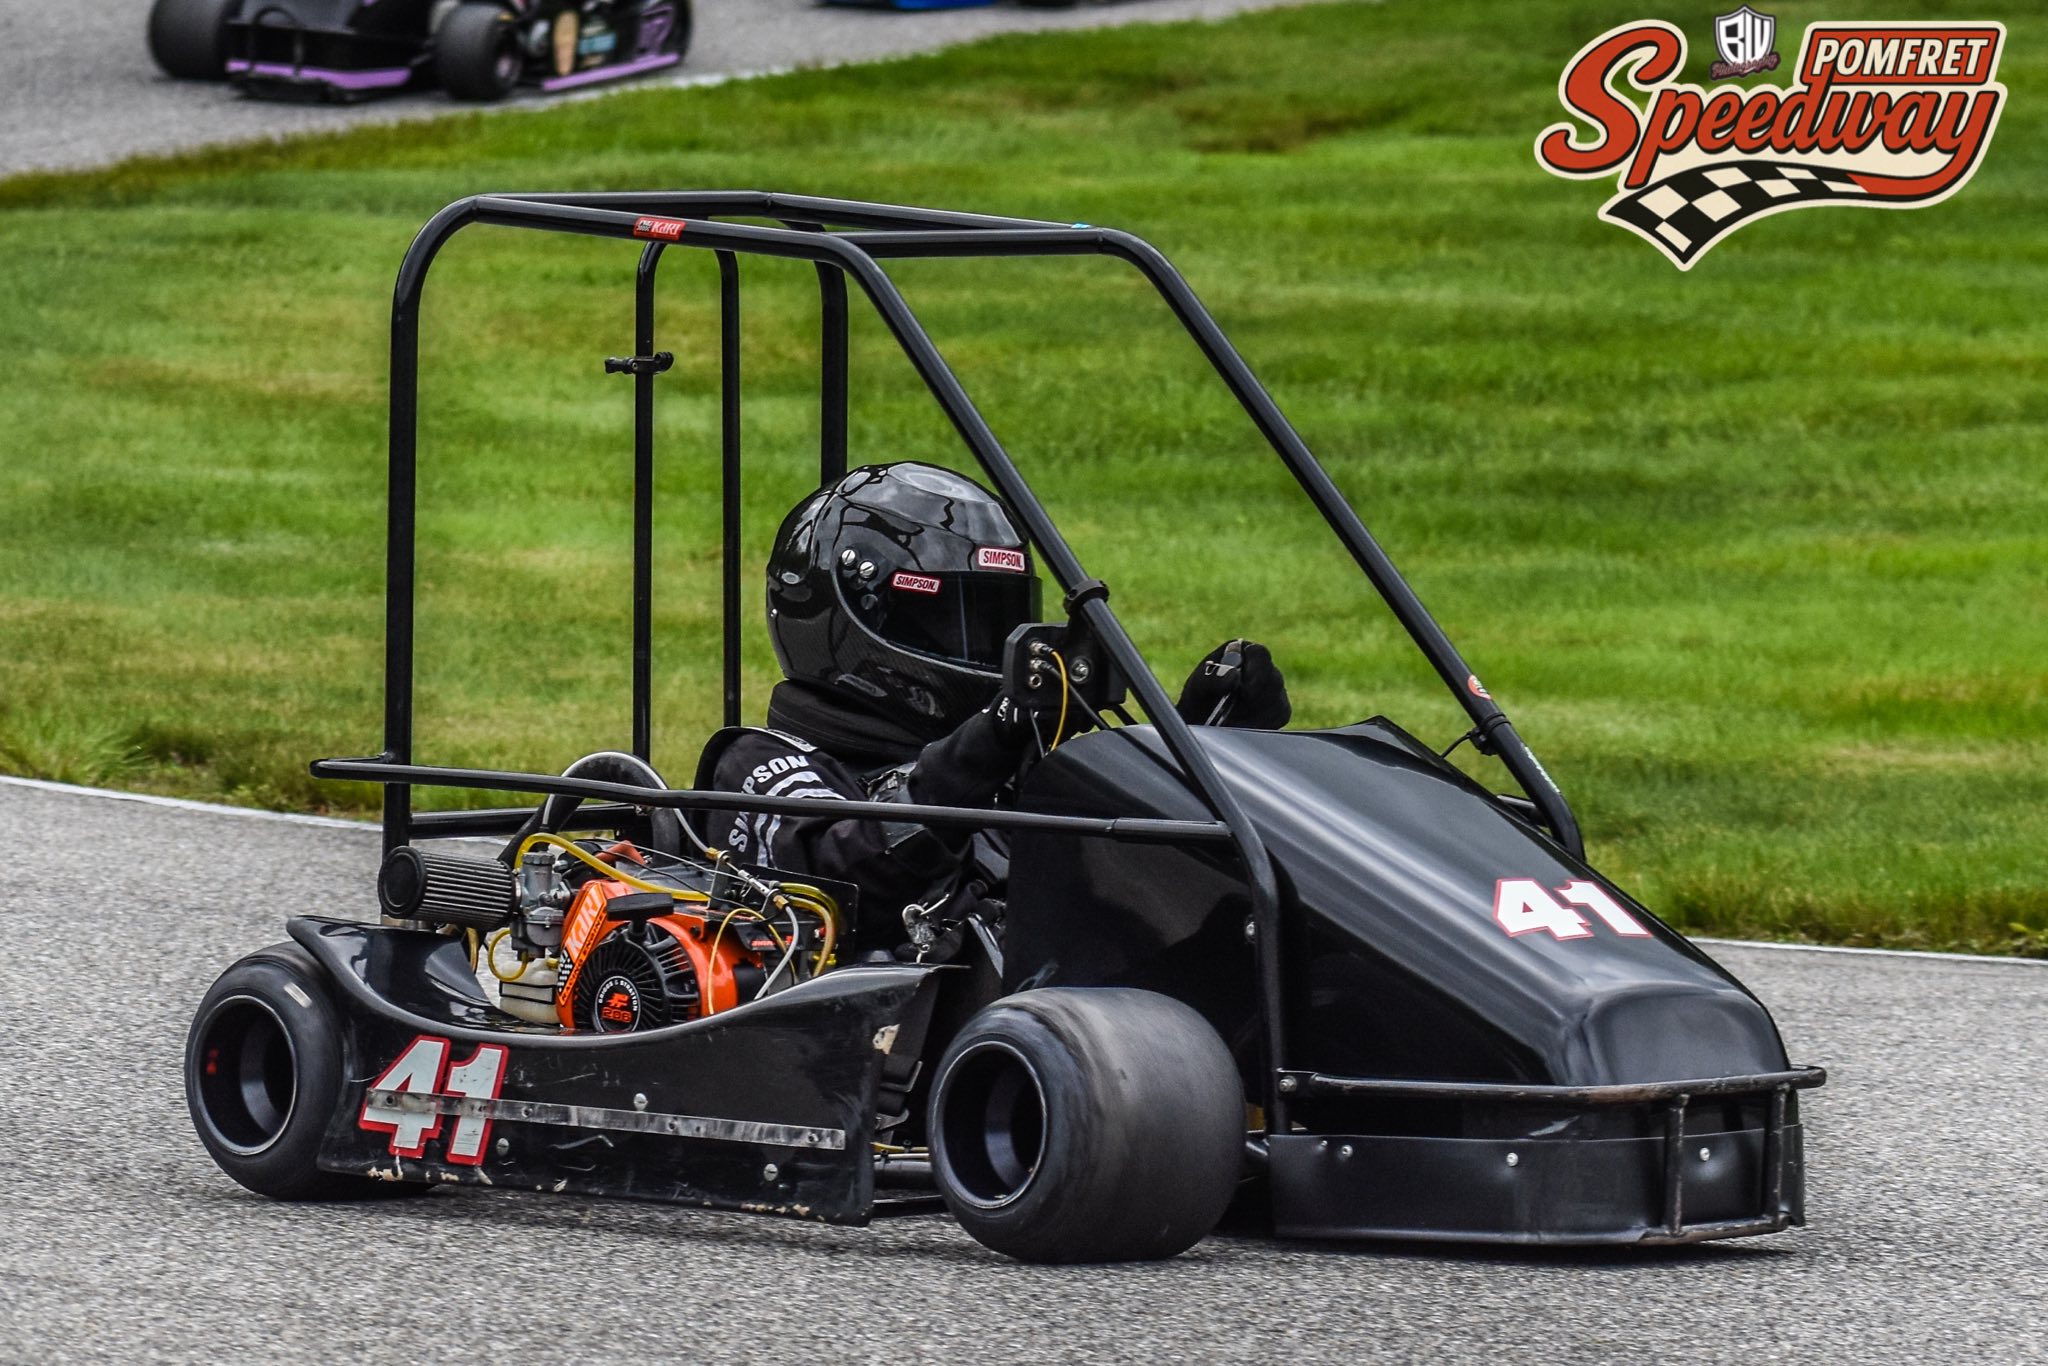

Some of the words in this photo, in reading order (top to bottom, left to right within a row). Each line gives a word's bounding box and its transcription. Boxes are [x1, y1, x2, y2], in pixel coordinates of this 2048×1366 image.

[983, 550, 1023, 568] SIMPSON
[895, 576, 936, 591] SIMPSON
[728, 755, 810, 853] SIPSON
[1492, 878, 1653, 941] 41
[602, 1006, 632, 1023] 206
[358, 1034, 510, 1167] 41
